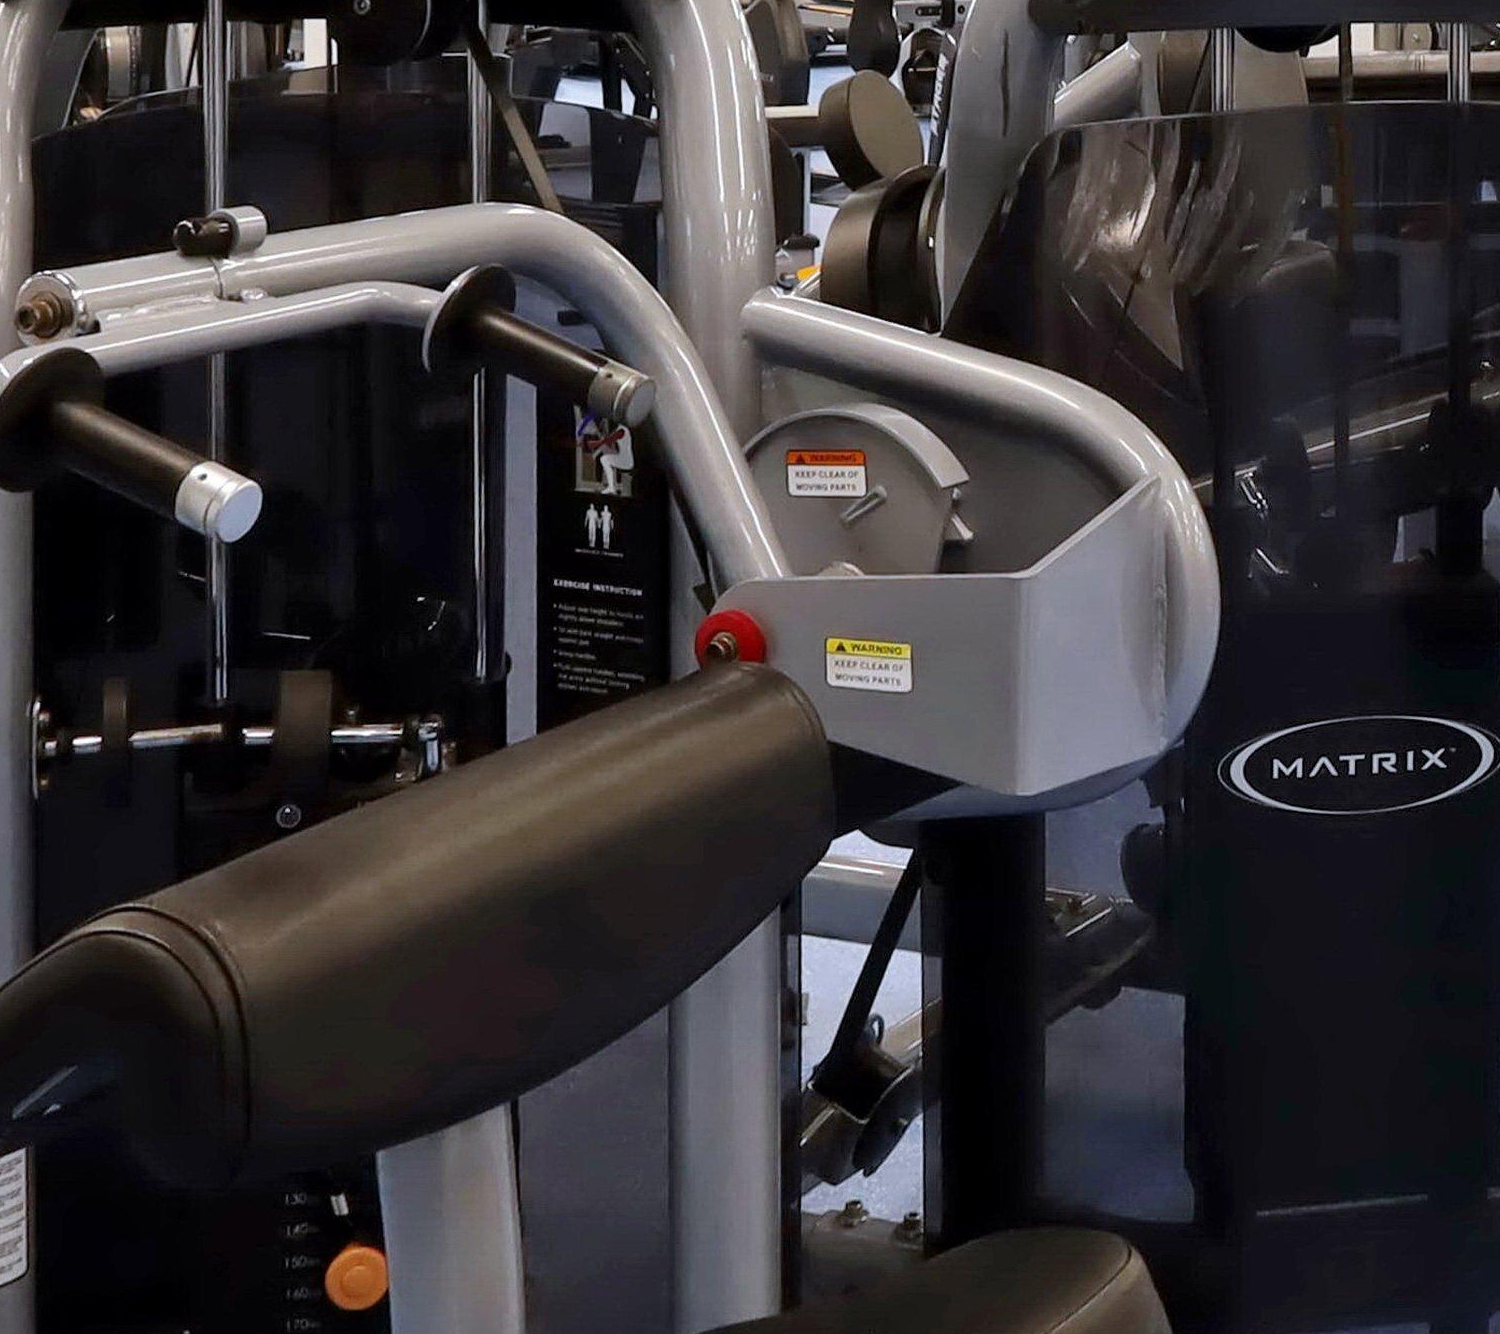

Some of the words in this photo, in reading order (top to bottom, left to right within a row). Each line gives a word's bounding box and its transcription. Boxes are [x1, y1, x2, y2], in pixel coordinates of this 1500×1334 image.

[819, 470, 845, 479] CLEAR
[796, 483, 828, 492] MOVING
[830, 483, 858, 492] PARTS
[850, 643, 903, 656] WARNING
[834, 659, 859, 668] KEEP
[859, 661, 891, 672] CLEAR
[891, 663, 904, 673] OF
[835, 673, 871, 683] MOVING
[871, 676, 902, 686] PARTS
[1271, 747, 1448, 780] MATRIX
